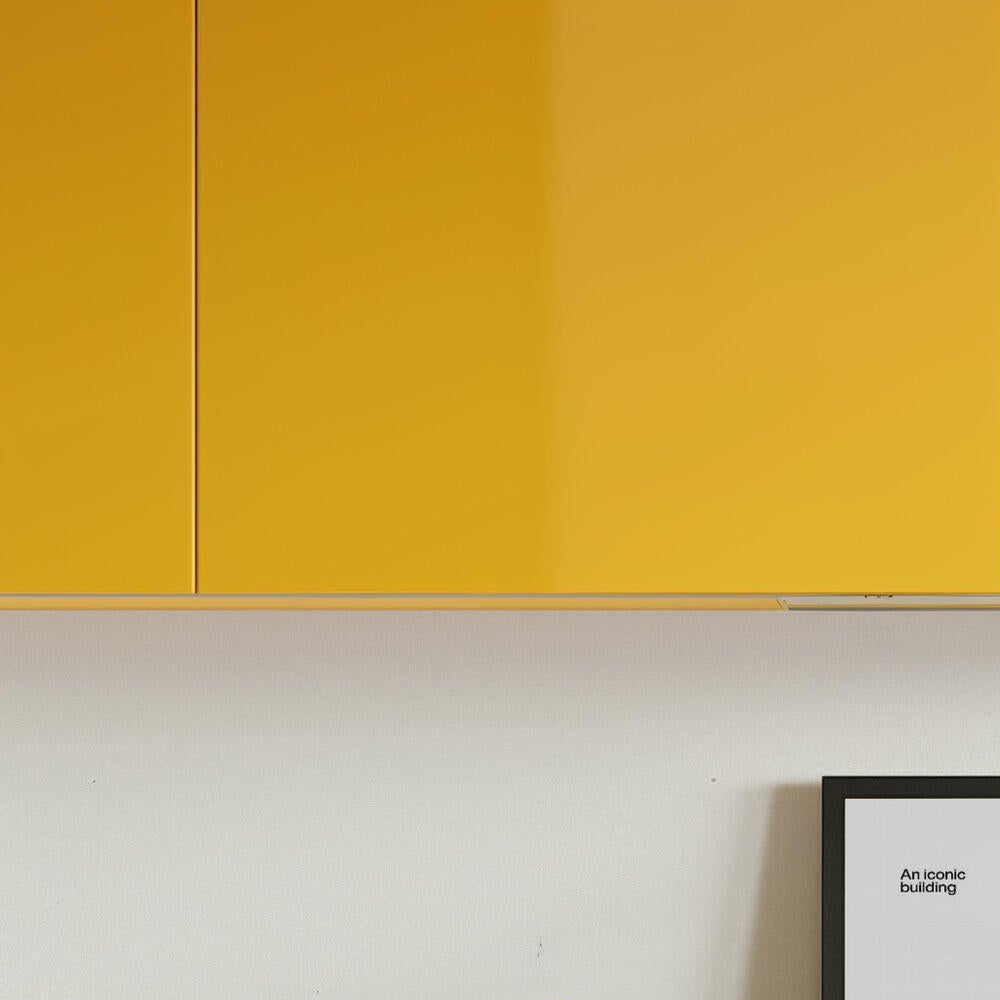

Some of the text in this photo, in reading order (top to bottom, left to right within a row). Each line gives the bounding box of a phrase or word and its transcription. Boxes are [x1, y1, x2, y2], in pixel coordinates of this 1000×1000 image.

[900, 868, 966, 880] An iconic
[900, 881, 957, 896] building
